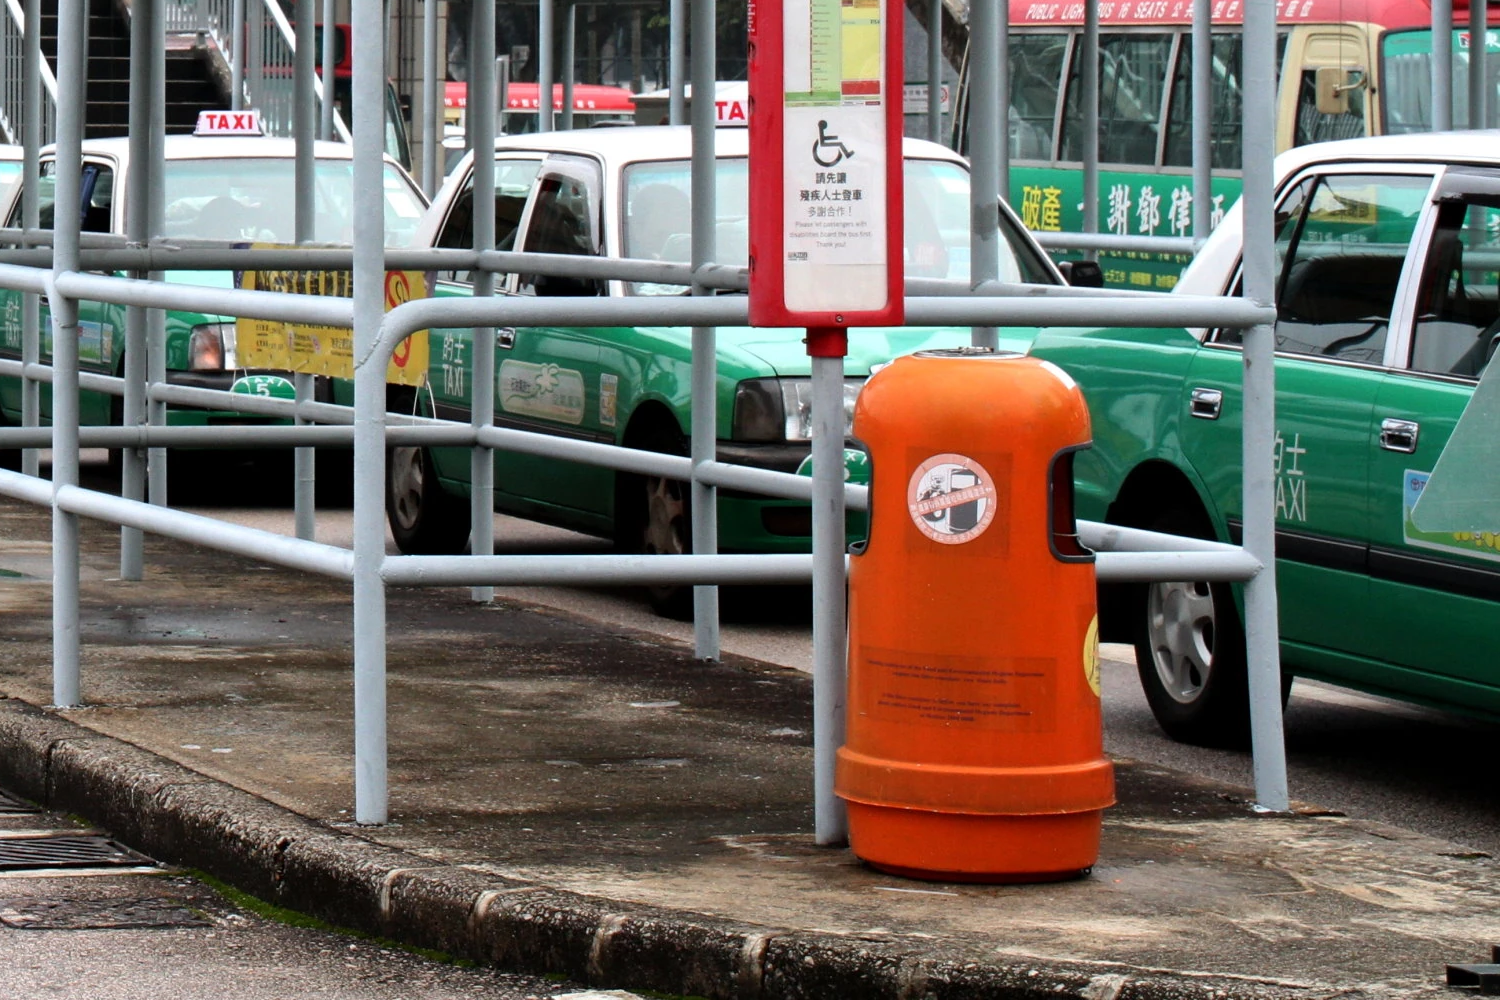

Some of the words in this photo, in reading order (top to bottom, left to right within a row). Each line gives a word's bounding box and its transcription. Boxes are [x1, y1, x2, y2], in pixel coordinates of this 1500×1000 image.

[1025, 3, 1058, 20] PUBLIC
[1061, 3, 1085, 20] LIGH
[1118, 2, 1131, 18] 16
[1134, 1, 1168, 18] SEATS
[715, 101, 747, 121] TA
[206, 114, 254, 130] TAXI
[816, 172, 847, 184] 請先讓
[800, 189, 862, 201] 殘疾人士登車
[1022, 185, 1062, 231] 破產
[443, 331, 465, 365] 的士
[256, 383, 270, 396] 5
[443, 364, 464, 398] TAXI
[1274, 477, 1306, 522] AXI
